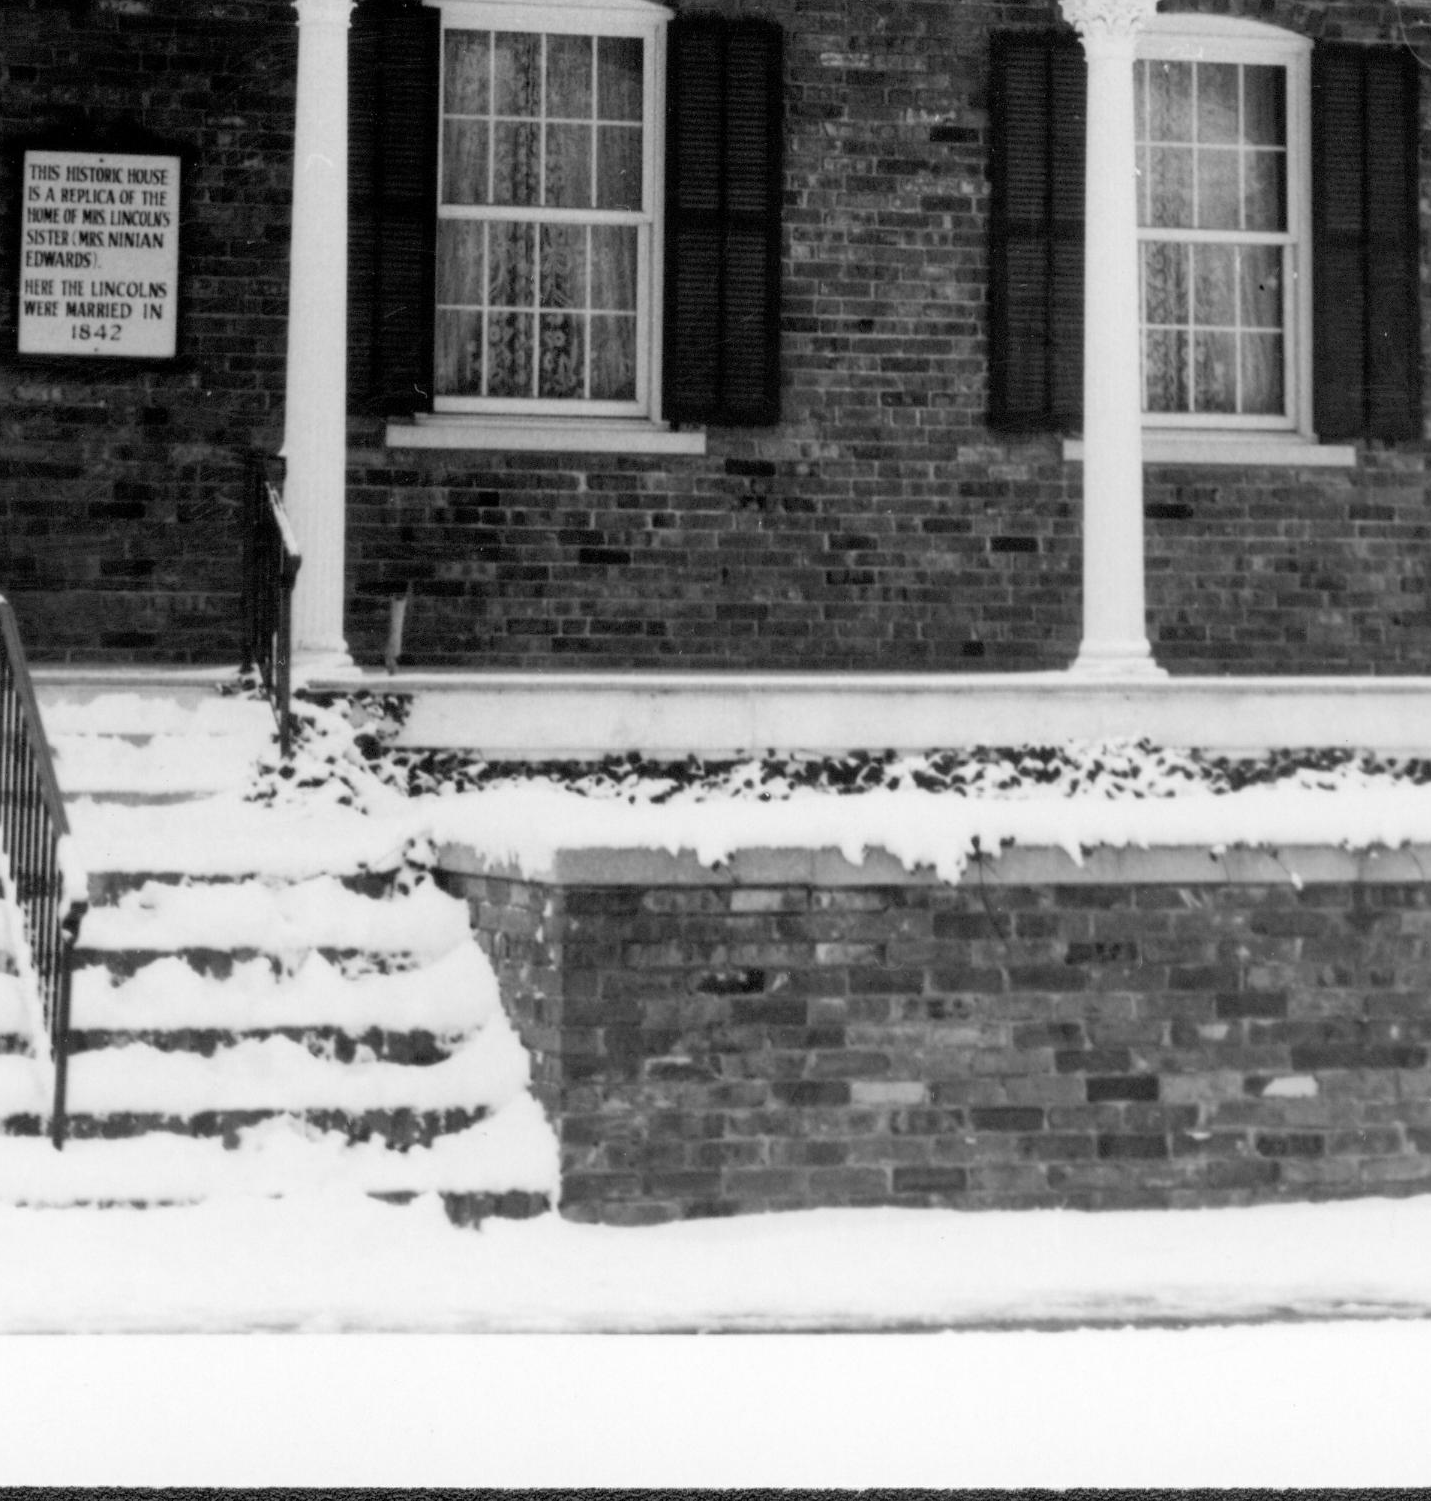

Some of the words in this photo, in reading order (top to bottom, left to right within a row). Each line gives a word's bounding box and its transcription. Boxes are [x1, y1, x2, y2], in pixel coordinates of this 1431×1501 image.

[29, 165, 60, 180] THIS
[66, 167, 123, 184] HISTORIC
[128, 168, 168, 185] HOUSE
[29, 187, 40, 201] IS
[45, 188, 55, 202] A
[61, 189, 115, 204] REPLICA
[120, 190, 135, 205] OF
[142, 191, 167, 206] THE
[28, 208, 59, 223] HOME
[64, 209, 78, 224] OF
[27, 230, 69, 245] SISTER
[108, 233, 163, 249] NINIAN
[25, 279, 54, 296] HERE
[61, 280, 83, 296] THE
[91, 281, 167, 298] LINCOLNS
[24, 301, 58, 316] WERE
[66, 303, 131, 319] MARRIED
[143, 304, 163, 319] IN
[71, 325, 122, 341] 1842
